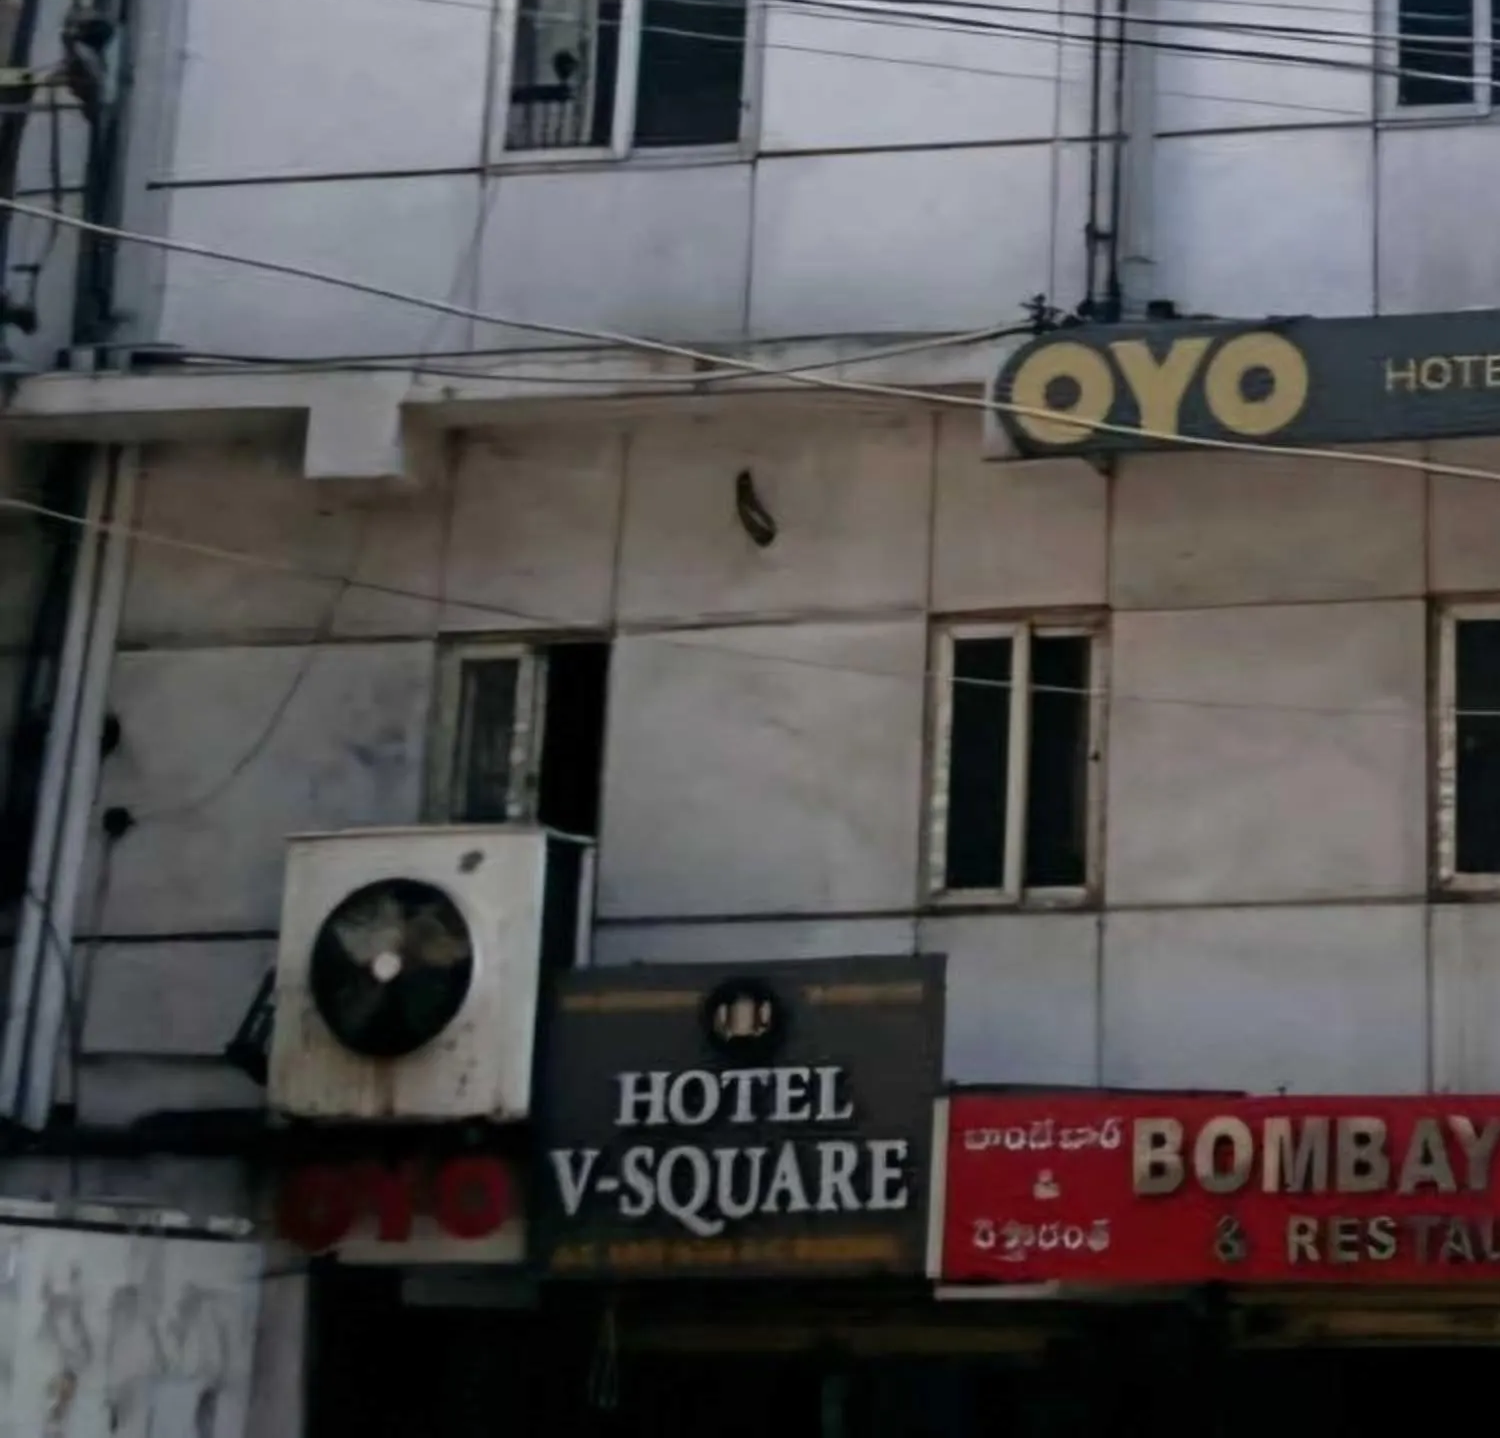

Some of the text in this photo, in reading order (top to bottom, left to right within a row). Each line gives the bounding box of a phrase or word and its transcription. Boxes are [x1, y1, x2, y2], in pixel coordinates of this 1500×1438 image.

[1012, 331, 1308, 446] OYO
[614, 1066, 854, 1128] HOTEL
[550, 1139, 909, 1236] V-SQUARE
[1213, 1215, 1245, 1263] &
